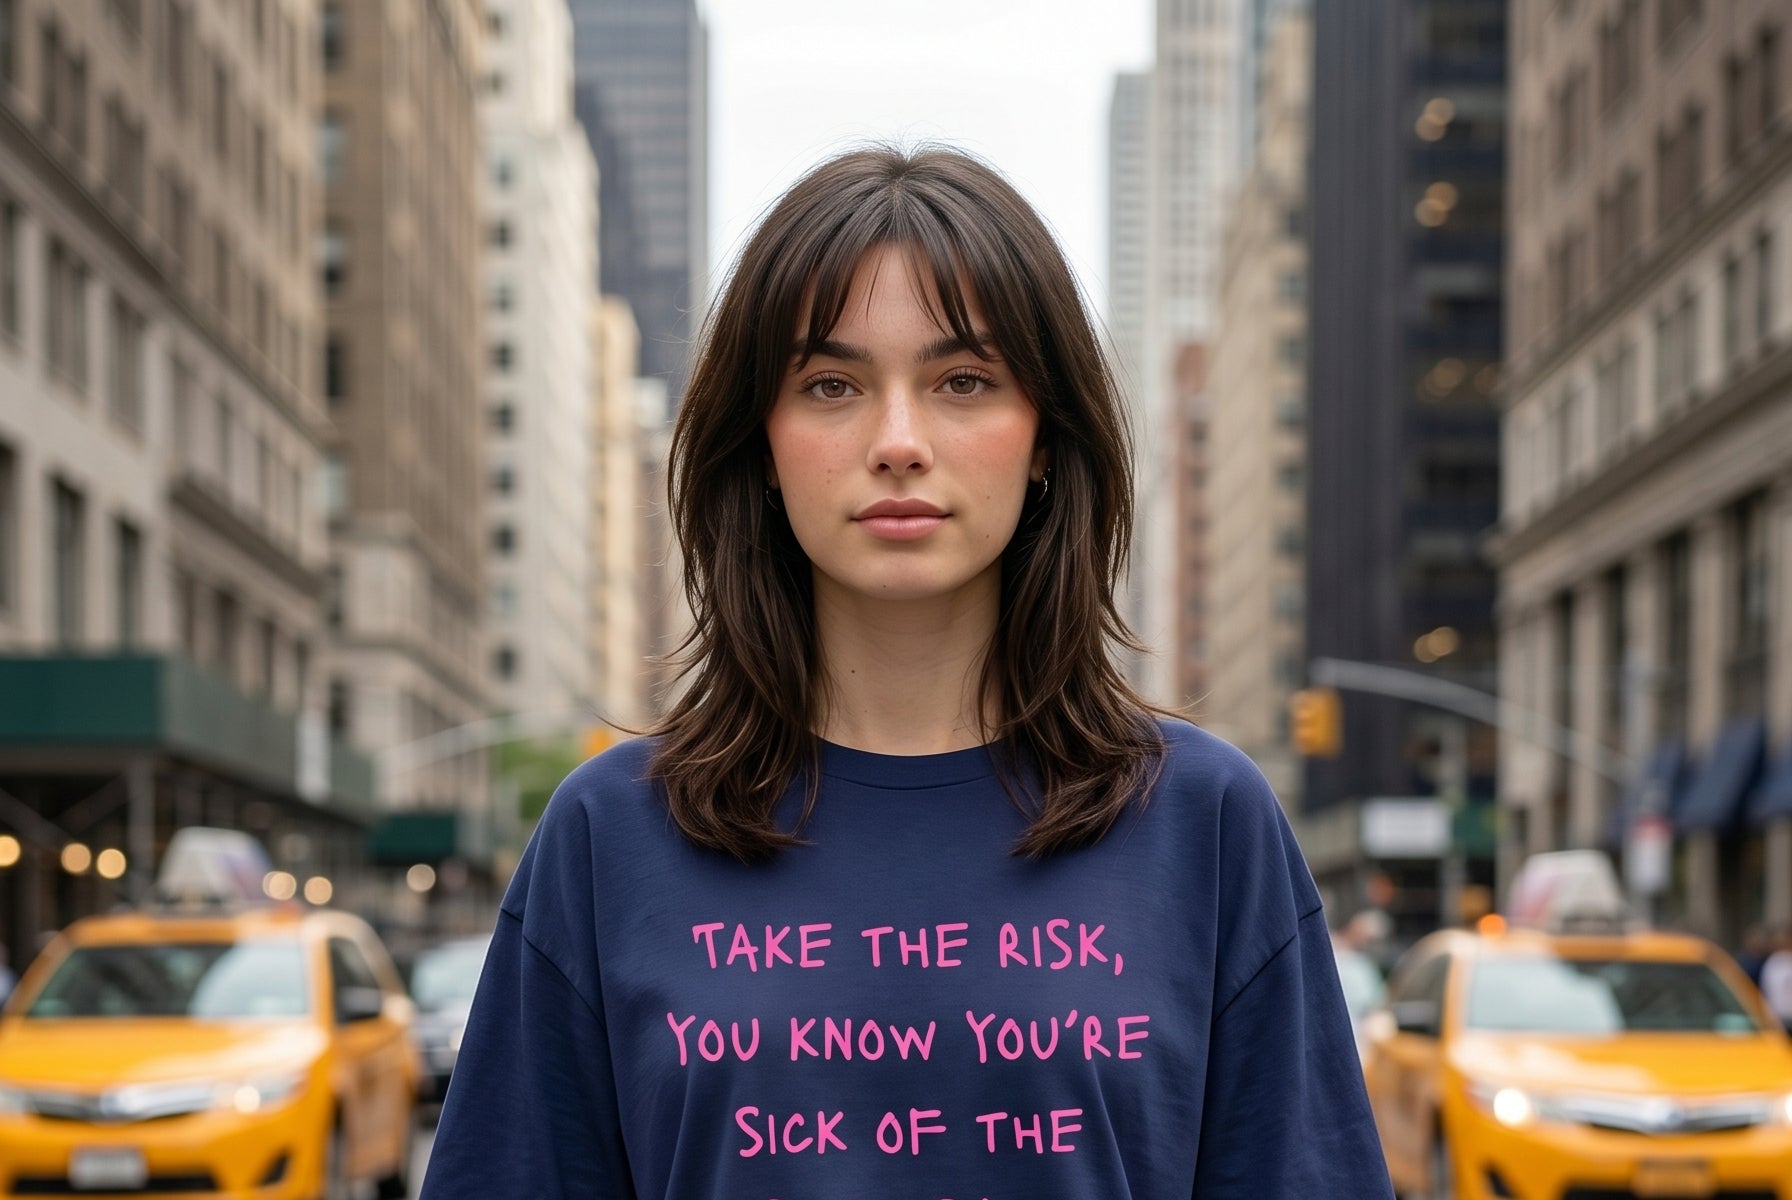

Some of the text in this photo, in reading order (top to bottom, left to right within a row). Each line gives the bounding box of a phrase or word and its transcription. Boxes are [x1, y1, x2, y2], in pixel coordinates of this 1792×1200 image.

[692, 918, 1124, 975] TAKE THE RISK,
[667, 1009, 1150, 1066] YOU KNOW YOU'RE
[735, 1105, 1083, 1158] SICK OF THE
